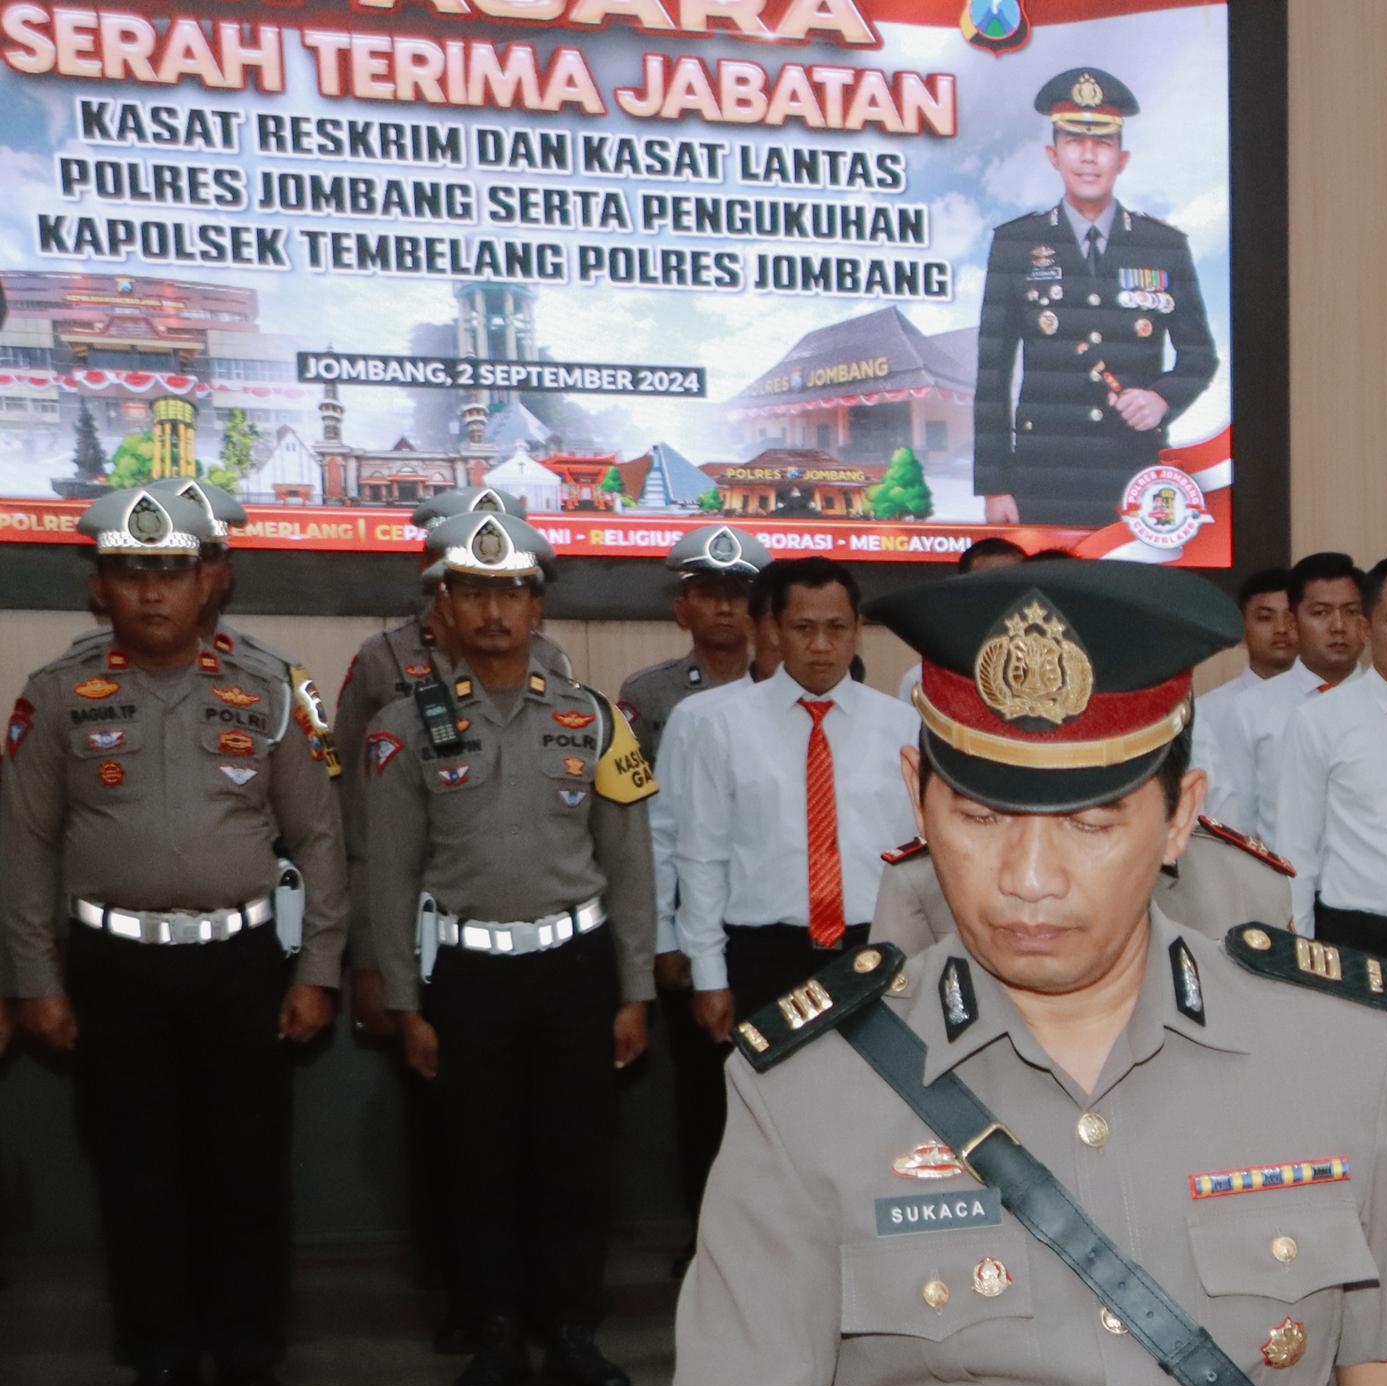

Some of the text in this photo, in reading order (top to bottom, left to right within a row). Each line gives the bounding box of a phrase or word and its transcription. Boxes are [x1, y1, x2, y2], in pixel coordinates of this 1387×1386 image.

[3, 8, 955, 136] SERAH TERIMA JABATAN
[81, 100, 903, 190] KASAT RESKRIM DAN KASAT LANTAS
[61, 158, 925, 245] POLRES JOMBANG SERTA PENGUKUHAN
[38, 215, 950, 298] KAPOLSEK TEMBELANG POLRES JOMBANG
[305, 357, 700, 393] JOMBANG, 2 SEPTEMBER 2024
[807, 357, 889, 388] JOMBANG
[726, 468, 866, 481] POLRES JOMBANG
[205, 708, 267, 730] POLRI
[890, 1200, 985, 1223] SUKACA
